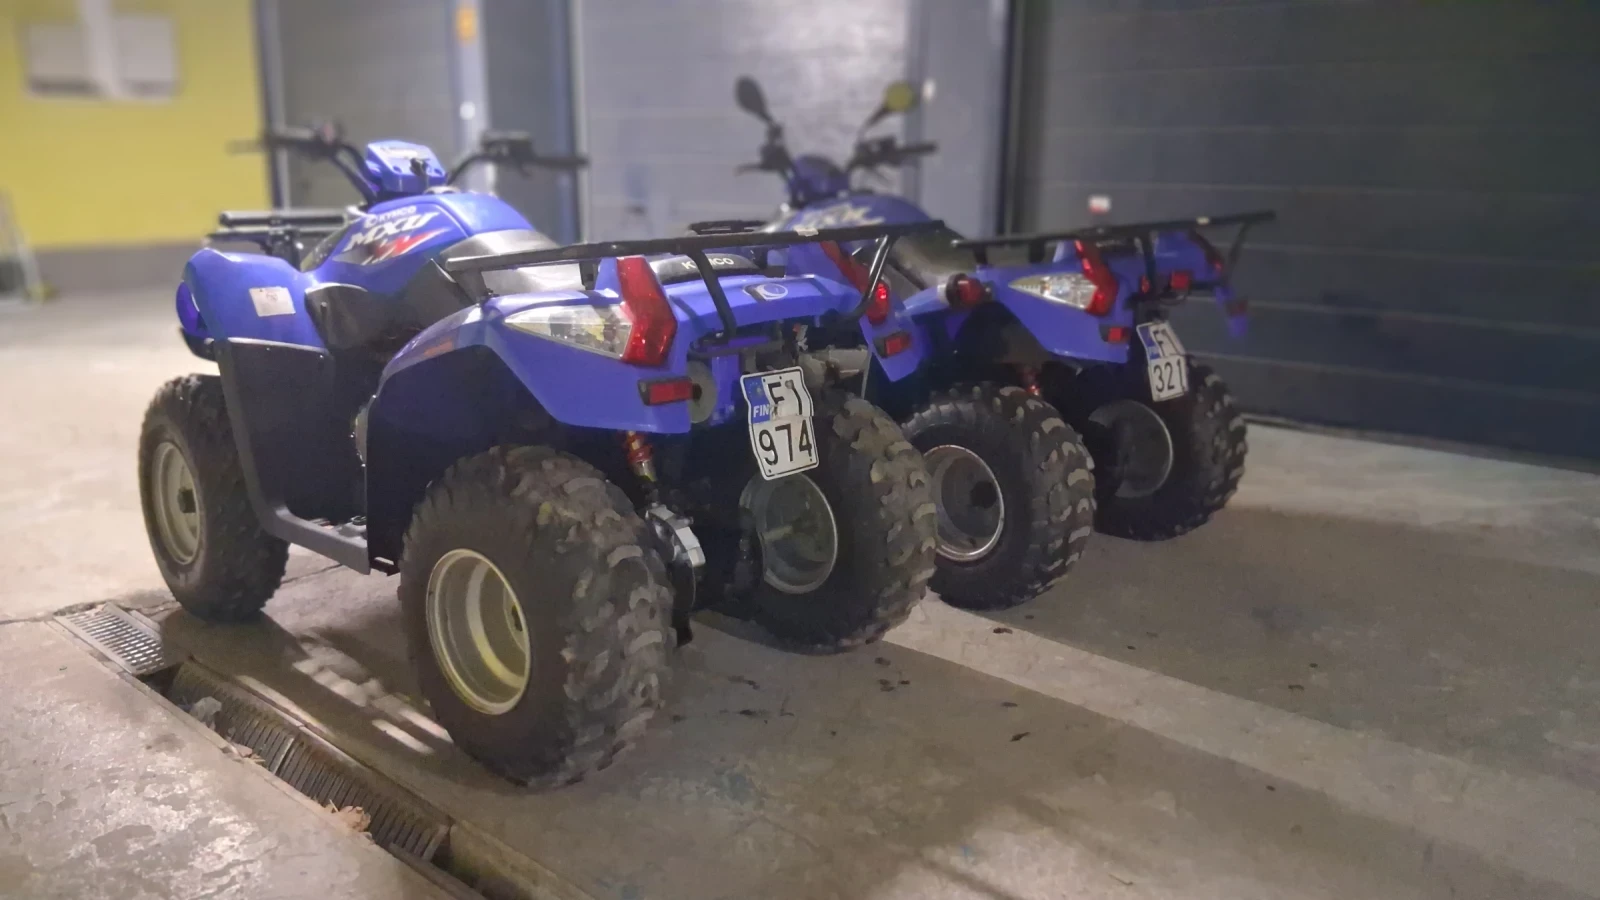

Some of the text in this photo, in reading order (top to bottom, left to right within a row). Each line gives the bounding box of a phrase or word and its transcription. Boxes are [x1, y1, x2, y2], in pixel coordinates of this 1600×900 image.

[342, 211, 440, 250] MXU
[681, 257, 735, 270] KCO
[1153, 358, 1185, 393] 321
[753, 403, 770, 418] FIN
[758, 418, 813, 466] 974
